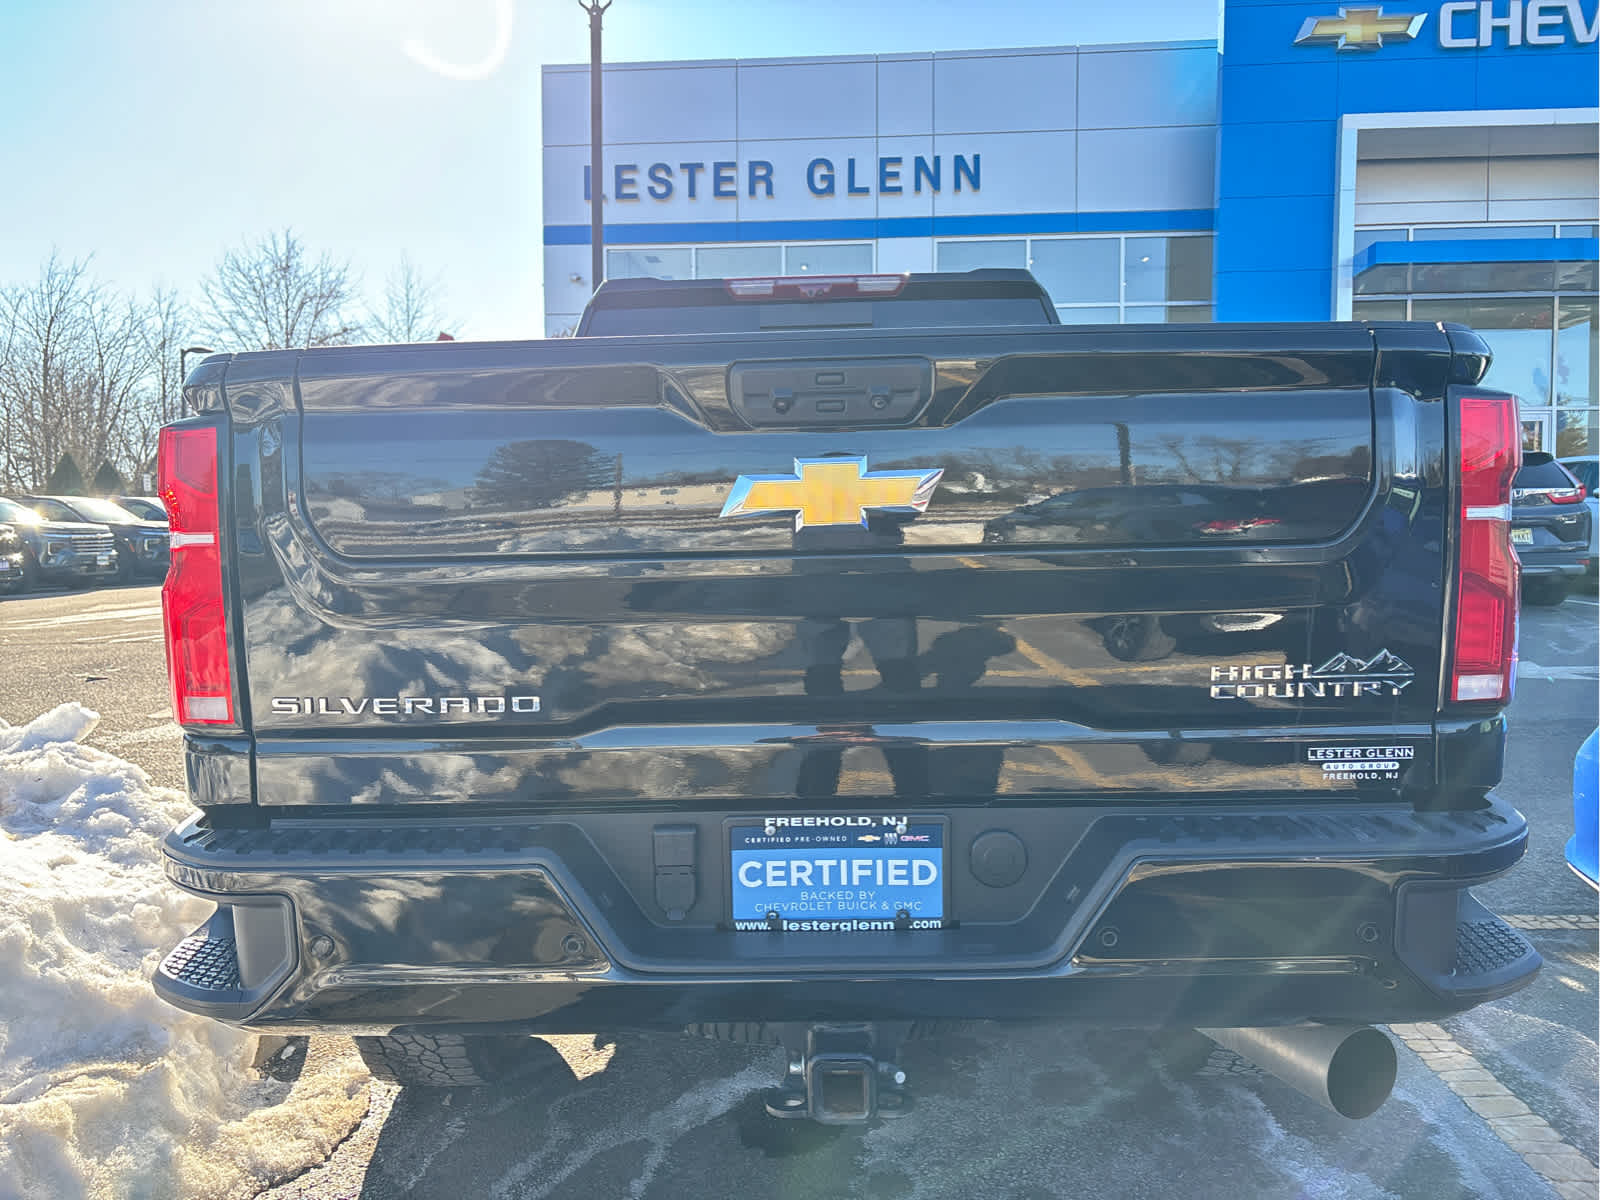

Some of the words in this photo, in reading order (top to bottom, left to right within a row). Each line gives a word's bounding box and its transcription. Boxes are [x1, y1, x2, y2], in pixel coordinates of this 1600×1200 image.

[1439, 0, 1600, 48] CHEV
[806, 153, 982, 197] GLENN
[1210, 663, 1313, 681] HIGH
[1210, 680, 1413, 700] COUNTRY
[271, 695, 542, 715] SILVERADO
[1308, 748, 1362, 760] LESTER
[1366, 747, 1414, 758] GLENN
[1360, 762, 1398, 770] GROUP
[1322, 772, 1382, 780] FREEHOLD,
[1385, 772, 1399, 780] NJ
[765, 816, 876, 828] FREEHOLD,
[882, 816, 908, 827] NJ
[744, 836, 792, 844] CERTIFIED
[794, 835, 847, 843] PRE-OWNED
[738, 859, 938, 888] CERTIFIED
[800, 890, 855, 901] BACKED
[858, 890, 876, 900] BY
[754, 901, 832, 913] CHEVROLET
[838, 901, 877, 911] BUICK
[882, 901, 890, 911] &
[893, 900, 923, 911] GMC
